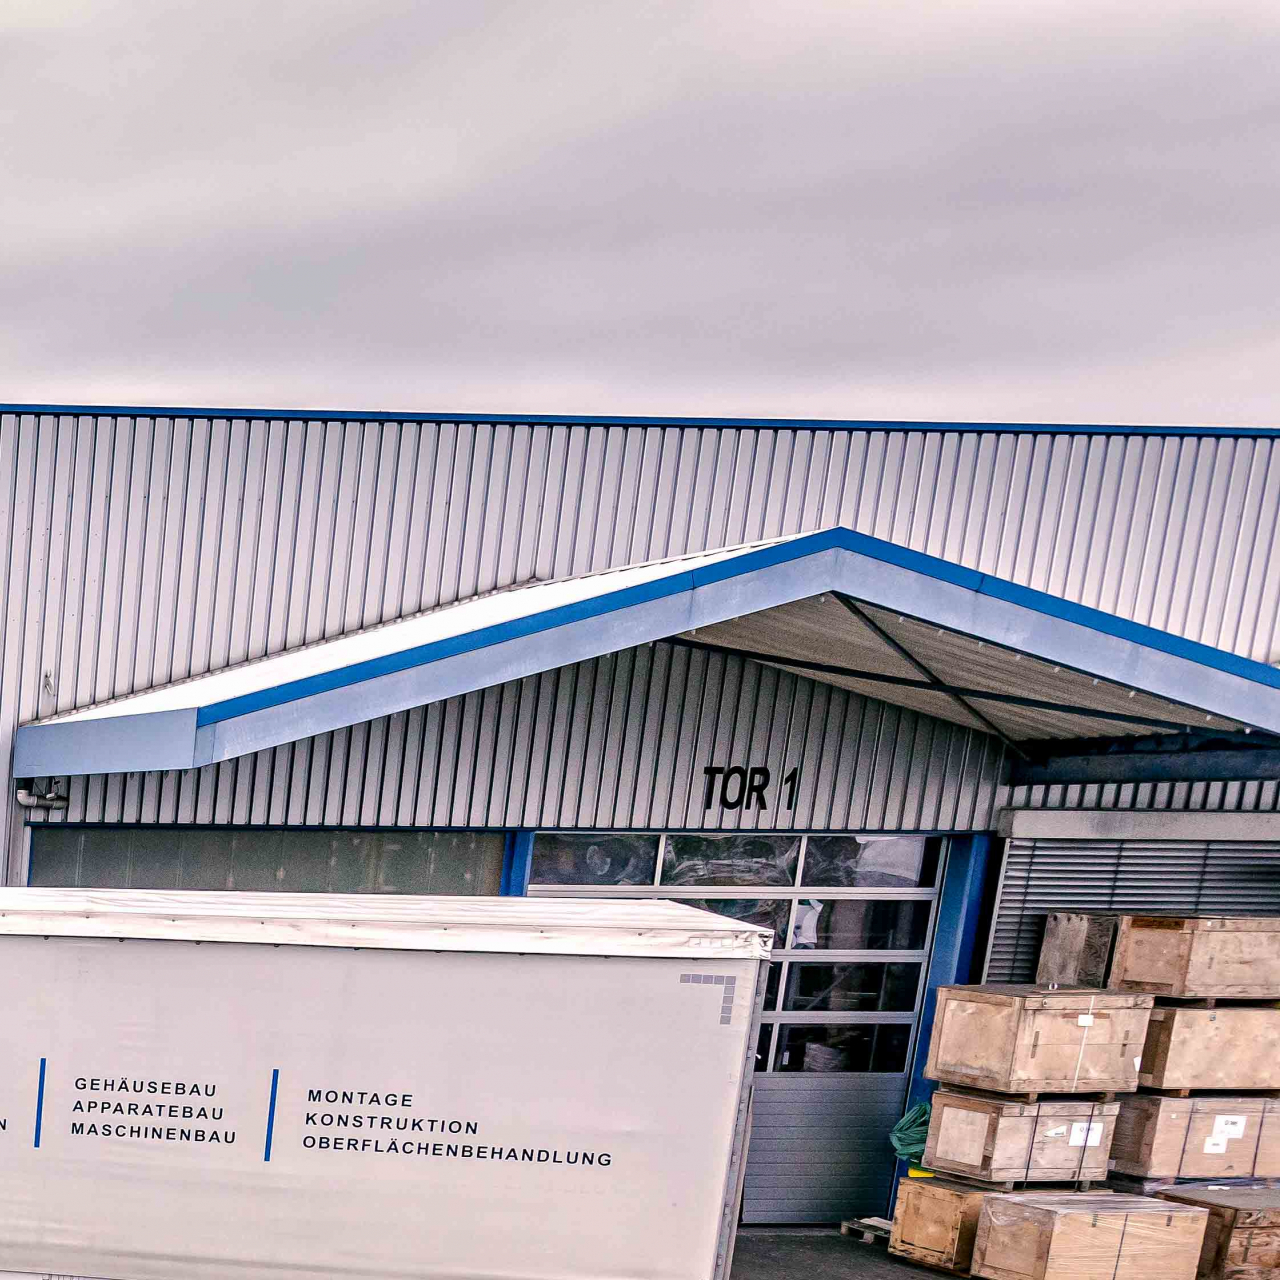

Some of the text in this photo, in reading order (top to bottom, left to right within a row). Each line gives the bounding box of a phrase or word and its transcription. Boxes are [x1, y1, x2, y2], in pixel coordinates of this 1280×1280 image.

[703, 766, 798, 810] TOR 1
[74, 1077, 216, 1097] GEHÄUSEBAU
[308, 1089, 413, 1107] MONTAGE
[72, 1100, 223, 1120] APPARATEBAU
[71, 1122, 236, 1144] MASCHINENBAU
[305, 1112, 478, 1135] KONSTRUKTION
[302, 1135, 612, 1167] OBERFLÄCHENBEHANDLUNG
